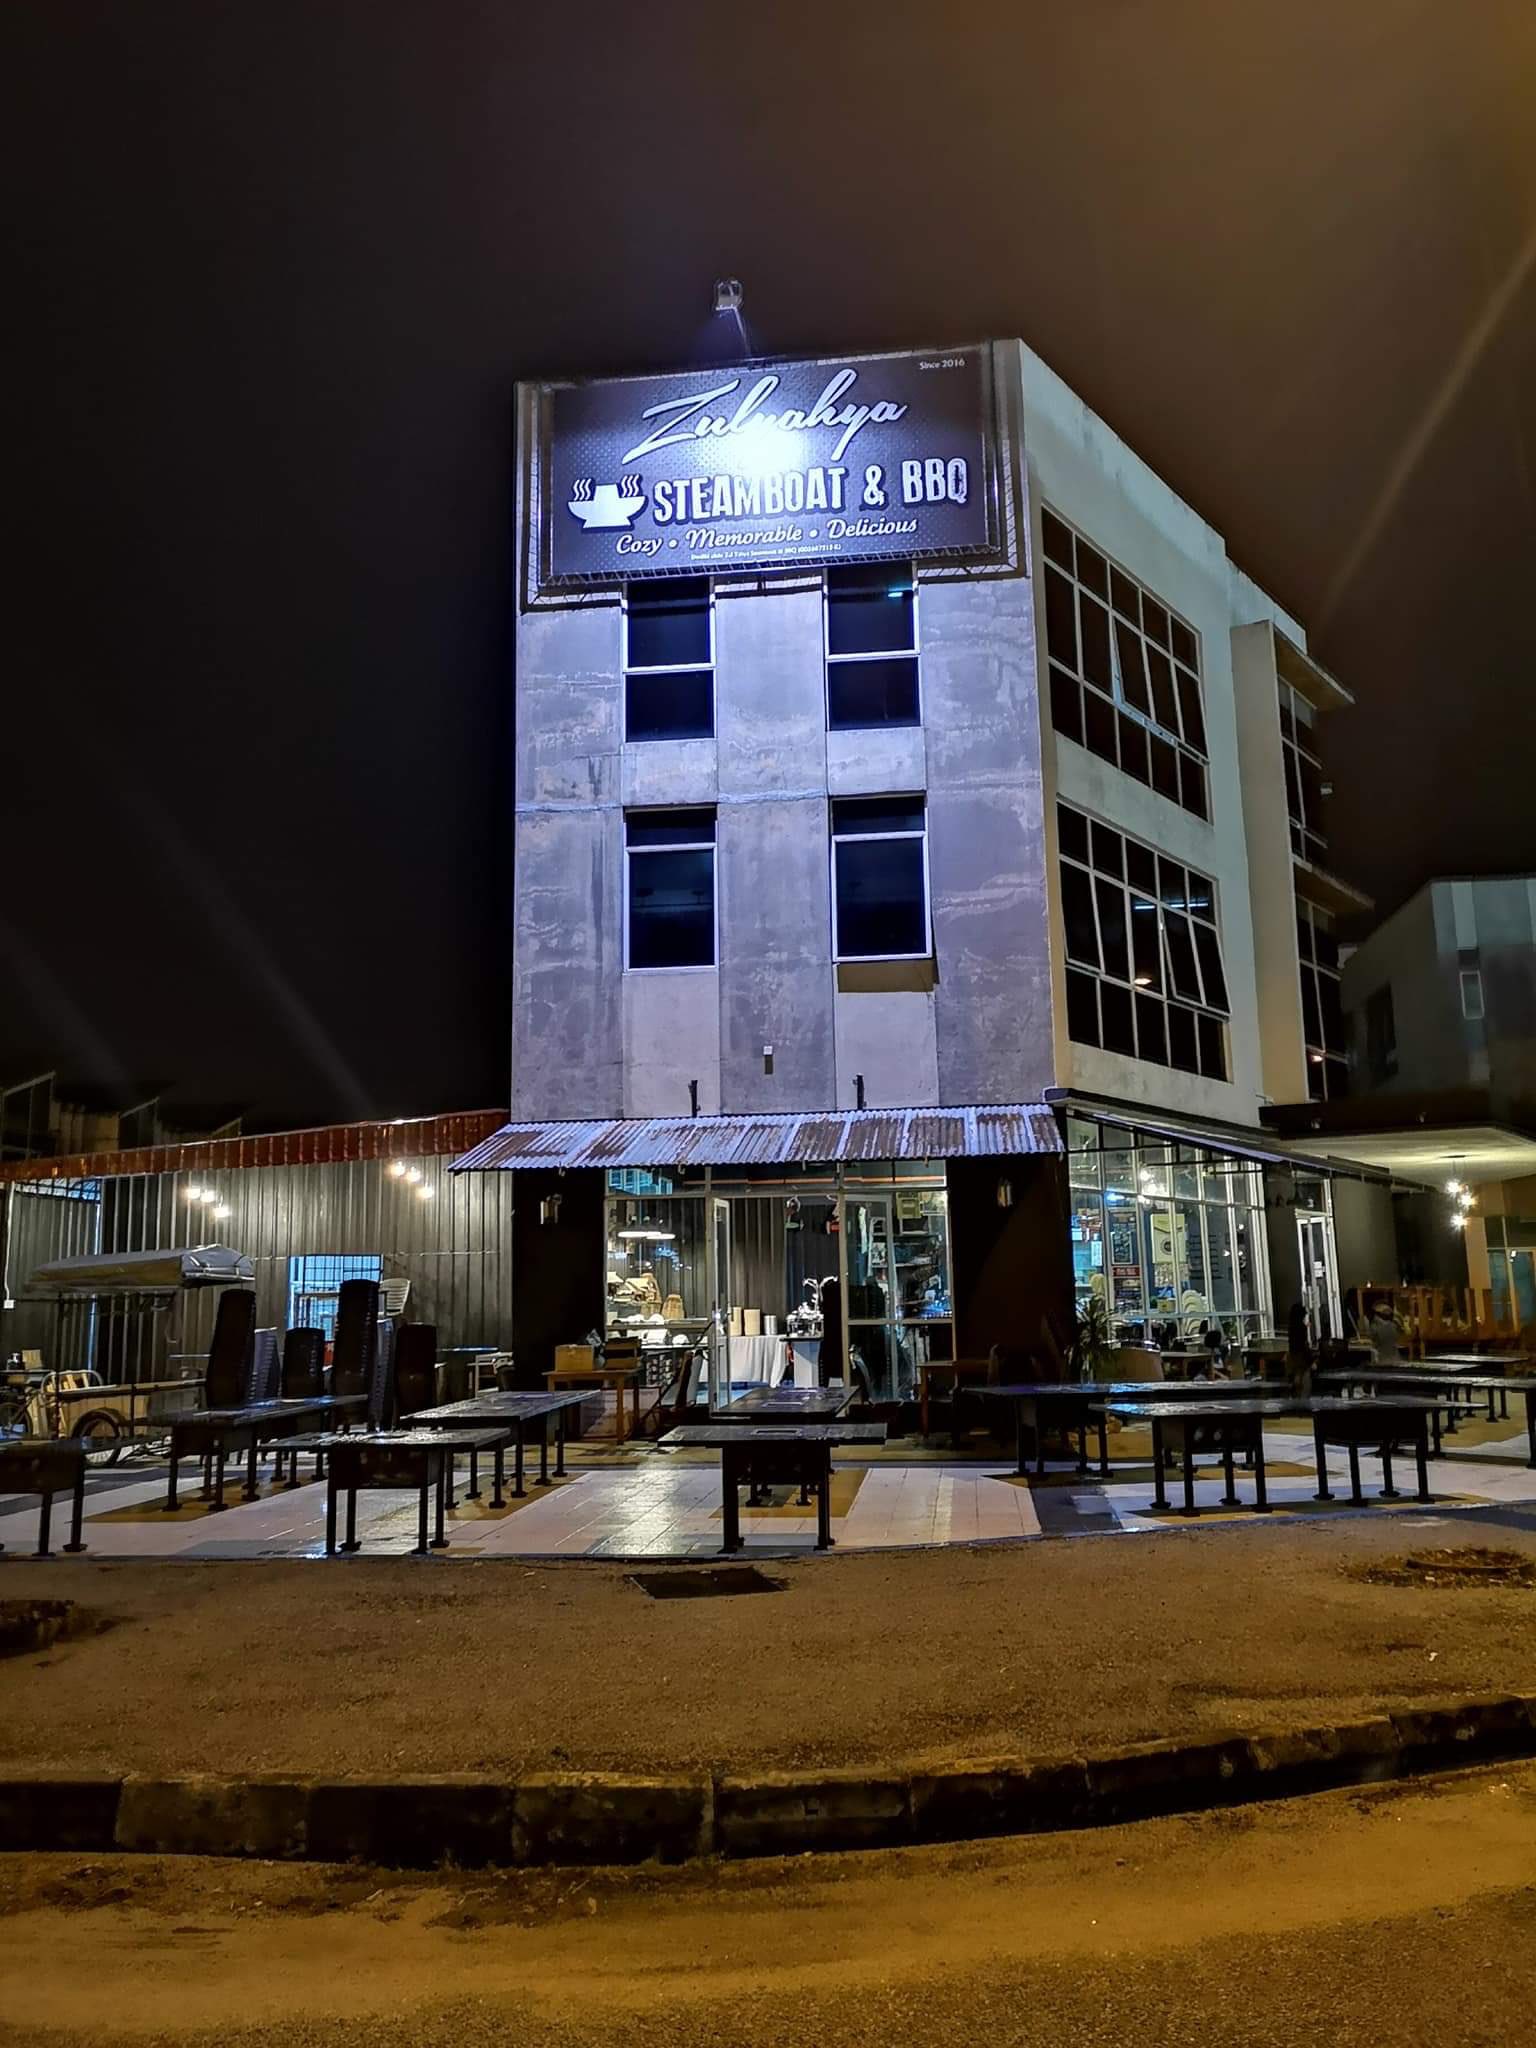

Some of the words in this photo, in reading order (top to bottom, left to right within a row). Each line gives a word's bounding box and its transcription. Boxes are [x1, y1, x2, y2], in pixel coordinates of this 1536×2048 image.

[919, 360, 940, 370] Since
[941, 358, 966, 368] 2016
[653, 466, 847, 523] STEAMBOAT
[862, 464, 886, 506] &
[901, 457, 968, 504] BBQ
[616, 533, 663, 557] Cozy
[685, 524, 802, 549] Memorable
[826, 517, 919, 539] Delicious
